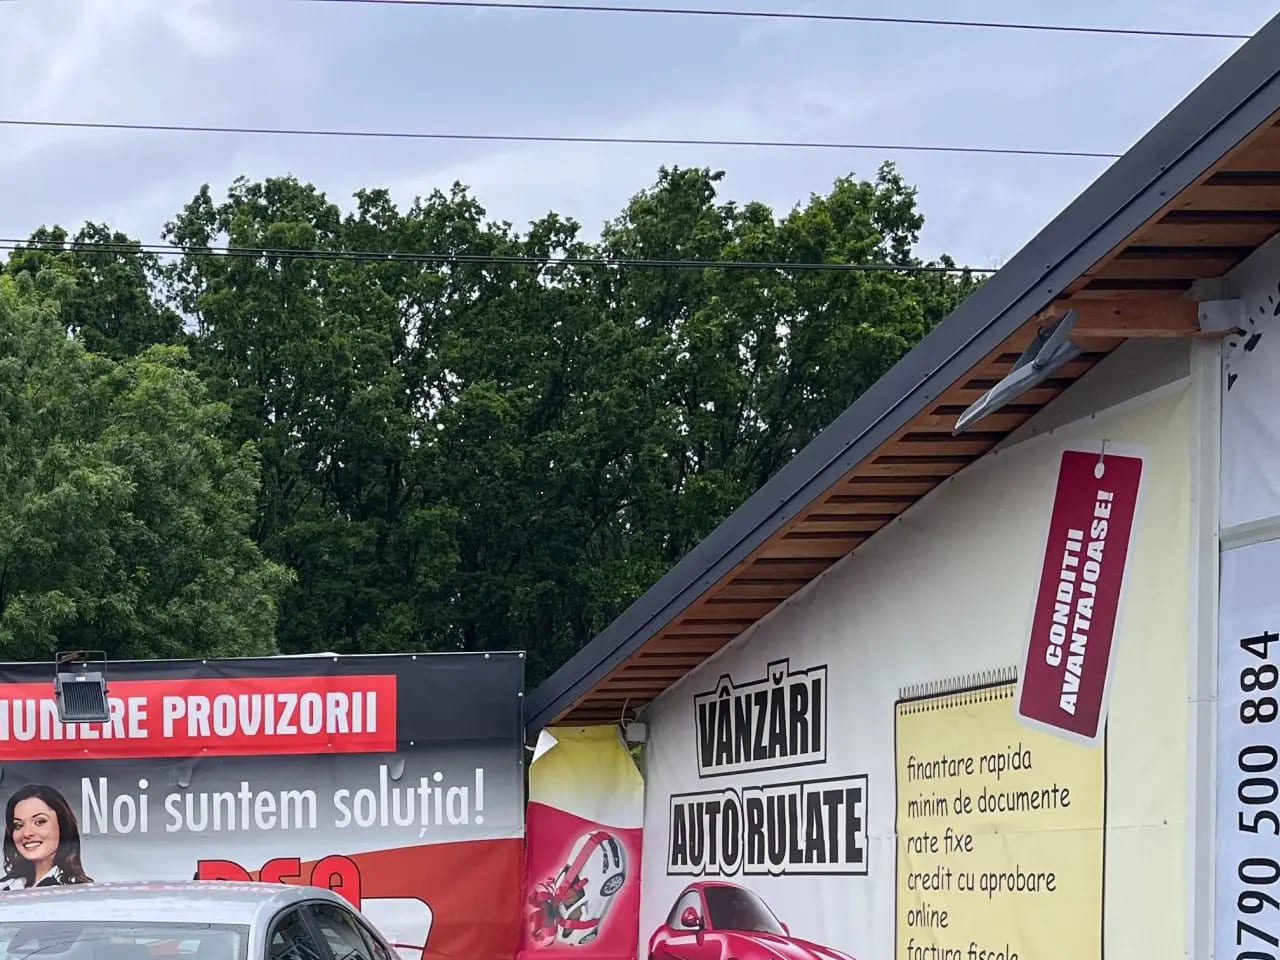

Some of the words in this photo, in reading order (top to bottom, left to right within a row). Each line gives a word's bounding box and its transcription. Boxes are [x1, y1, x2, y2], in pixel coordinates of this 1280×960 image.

[1044, 528, 1084, 667] CONDITII
[1059, 489, 1114, 716] AVANTAJOASE!
[162, 690, 378, 739] PROVIZORII
[1239, 630, 1280, 725] 884
[698, 670, 822, 768] VÂNZĂRI
[906, 754, 975, 783] finantare
[979, 742, 1033, 781] rapida
[1238, 744, 1280, 836] 500
[80, 776, 149, 835] Noi
[164, 781, 318, 834] suntem
[332, 764, 485, 838] soluția!
[671, 798, 739, 867] AUTO
[746, 787, 864, 867] RULATE
[907, 791, 949, 819] minim
[953, 788, 973, 815] de
[977, 783, 1072, 815] documente
[907, 831, 939, 855] rate
[943, 827, 975, 855] fixe
[907, 864, 953, 892] credit
[957, 872, 975, 892] cu
[979, 864, 1057, 900] aprobare
[907, 901, 950, 929] online
